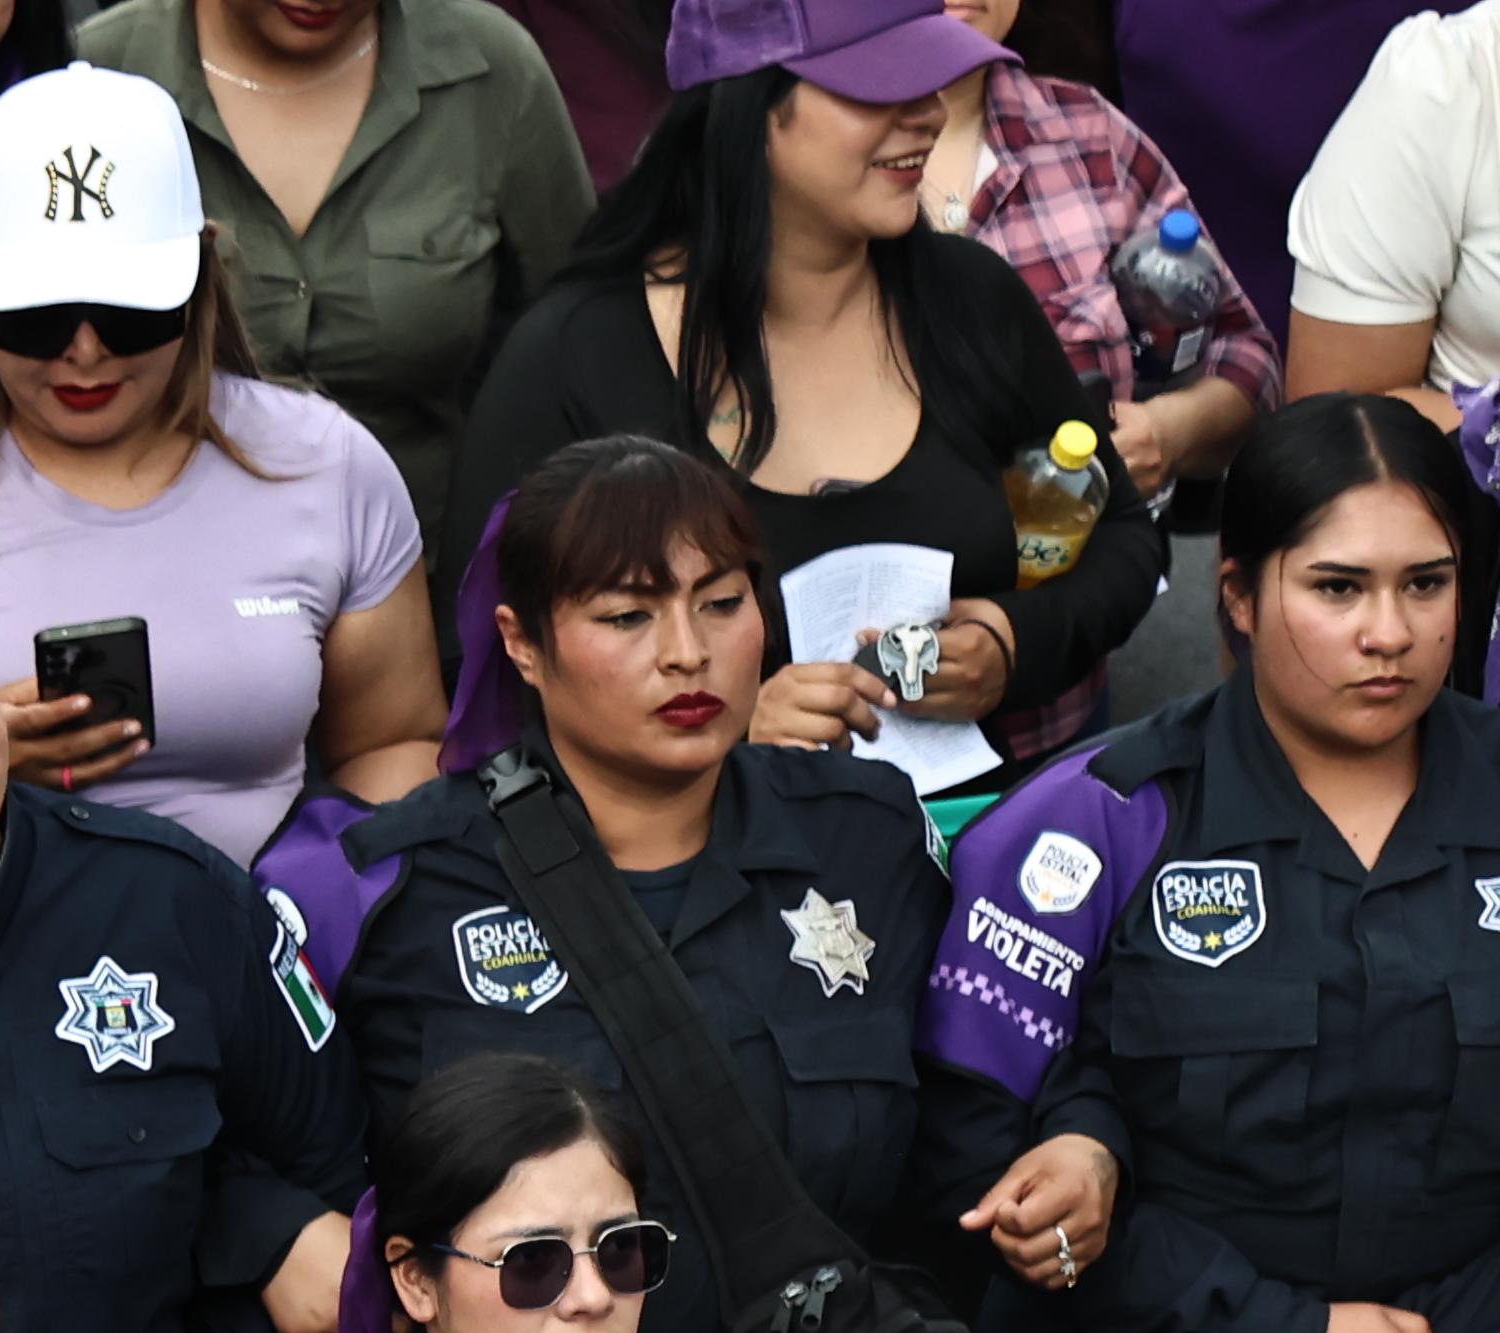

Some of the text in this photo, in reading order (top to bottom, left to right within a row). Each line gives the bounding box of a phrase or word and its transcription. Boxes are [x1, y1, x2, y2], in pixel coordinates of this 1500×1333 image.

[1162, 871, 1246, 897] POLICÍA
[1165, 890, 1248, 912] ESTATAL
[1177, 905, 1241, 920] COAHUILA
[466, 917, 539, 945] POLICÍ
[973, 897, 1084, 970] AGRUPAMIENTO
[482, 951, 547, 971] COAHUILA
[967, 909, 1073, 997] VIOLETA
